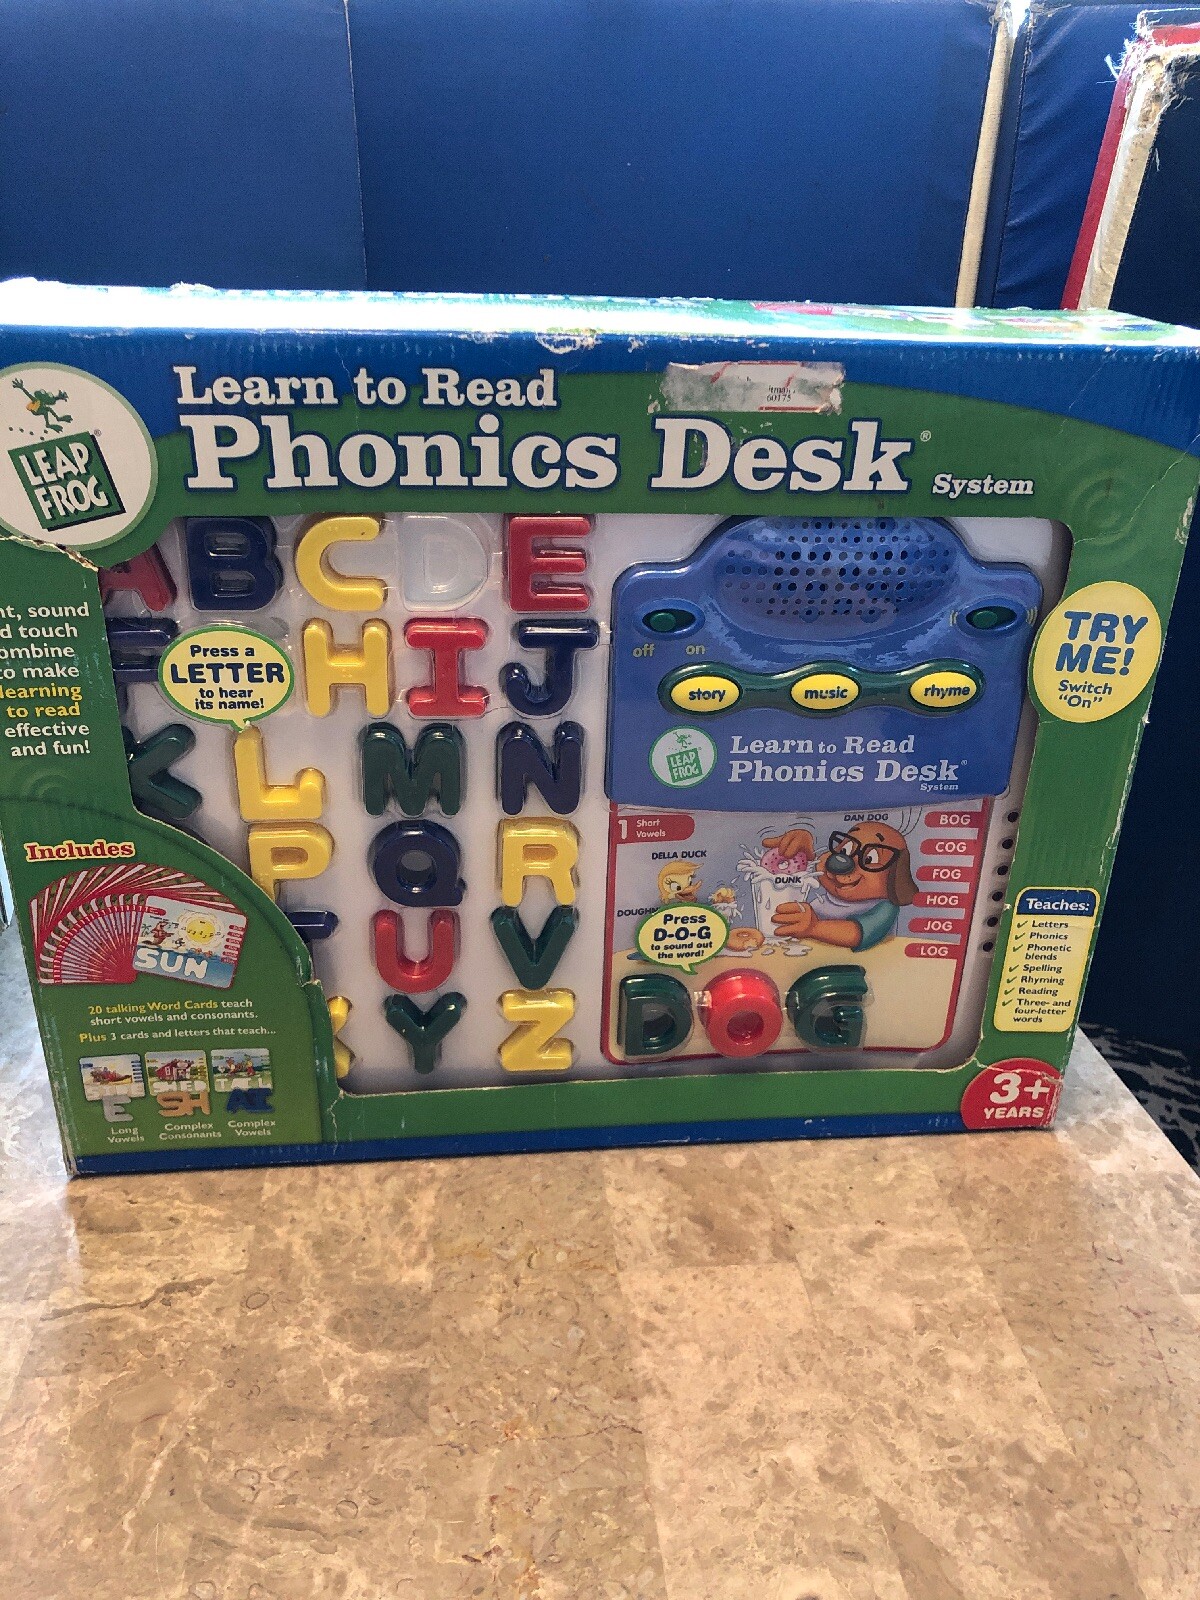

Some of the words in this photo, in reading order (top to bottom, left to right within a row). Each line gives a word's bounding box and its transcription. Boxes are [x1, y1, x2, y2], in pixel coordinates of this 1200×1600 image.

[173, 366, 338, 406] Learn
[354, 368, 407, 406] to
[421, 368, 558, 407] Read
[180, 414, 618, 490] Phonics
[651, 417, 915, 492] Desk
[19, 442, 90, 486] LEAP
[932, 473, 1035, 499] System
[34, 475, 109, 520] FROG
[187, 515, 283, 611] B
[295, 514, 389, 611] C
[402, 514, 490, 611] D
[506, 515, 593, 613] E
[28, 602, 90, 618] sound
[18, 623, 78, 638] touch
[1064, 610, 1149, 645] TRY
[190, 645, 241, 658] Press
[244, 647, 256, 657] a
[632, 643, 655, 659] off
[686, 644, 706, 656] on
[1055, 642, 1135, 676] ME!
[23, 663, 80, 679] make
[170, 663, 285, 684] LETTER
[302, 618, 394, 719] H
[405, 618, 490, 719] I
[499, 618, 599, 718] J
[0, 683, 83, 701] learning
[199, 688, 215, 699] to
[218, 687, 254, 699] hear
[688, 687, 726, 703] story
[804, 686, 848, 700] music
[923, 683, 970, 700] rhyme
[1058, 680, 1113, 695] Switch
[7, 706, 29, 719] to
[35, 702, 81, 717] read
[194, 698, 214, 710] its
[218, 698, 265, 710] name!
[5, 721, 90, 738] effective
[11, 741, 47, 757] and
[53, 740, 91, 755] fun!
[730, 735, 814, 755] Learn
[818, 740, 837, 755] to
[842, 735, 915, 754] Read
[670, 752, 696, 768] LEAP
[233, 724, 326, 820] L
[361, 721, 469, 816] M
[496, 721, 586, 816] N
[673, 763, 700, 780] FROG
[727, 760, 864, 783] Phonics
[874, 760, 960, 783] Desk
[920, 782, 960, 793] System
[843, 813, 864, 823] DAN
[866, 812, 889, 822] DOG
[939, 814, 971, 826] BOG
[617, 820, 627, 840] 1
[635, 819, 660, 829] Short
[635, 828, 667, 839] Vowels
[25, 840, 135, 861] Includes
[934, 841, 967, 853] COG
[370, 819, 467, 907] Q
[497, 817, 580, 906] R
[651, 851, 680, 861] DELLA
[682, 849, 707, 860] DUCK
[774, 875, 801, 885] DUNK
[932, 868, 962, 880] FOG
[926, 893, 959, 905] HOG
[1026, 898, 1090, 912] Teaches:
[663, 914, 707, 926] Press
[923, 920, 953, 932] JOG
[1031, 920, 1069, 929] Letters
[653, 926, 712, 942] D-O-G
[1029, 932, 1069, 941] Phonics
[372, 909, 461, 994] U
[491, 906, 579, 990] V
[663, 942, 693, 951] sound
[696, 941, 713, 949] out
[920, 945, 949, 957] LOG
[1027, 943, 1072, 952] Phonetic
[657, 952, 674, 960] the
[676, 950, 705, 959] word!
[1024, 952, 1058, 961] blends
[134, 947, 208, 979] SUN
[1022, 964, 1063, 974] Spelling
[1020, 975, 1065, 986] Rhyming
[1018, 987, 1059, 997] Reading
[88, 1005, 103, 1015] 20
[106, 1003, 146, 1014] talking
[147, 1001, 181, 1011] Word
[184, 1000, 219, 1010] Cards
[221, 998, 253, 1008] teach
[1017, 998, 1051, 1008] Three-
[1052, 998, 1072, 1008] and
[90, 1016, 122, 1026] short
[125, 1013, 163, 1024] vowels
[167, 1011, 188, 1021] and
[190, 1011, 258, 1021] consonants.
[1014, 1007, 1067, 1016] four-letter
[1012, 1015, 1043, 1024] words
[80, 1032, 107, 1043] Plus
[110, 1032, 117, 1041] 3
[120, 1030, 149, 1040] cards
[152, 1029, 172, 1039] and
[174, 1028, 210, 1037] letters
[213, 1027, 235, 1036] that
[383, 992, 467, 1074] Y
[497, 987, 576, 1071] Z
[989, 1072, 1050, 1105] 3+
[983, 1107, 1044, 1120] YEARS
[164, 1121, 214, 1132] Complex
[227, 1119, 276, 1129] Complex
[107, 1135, 145, 1144] Vowels
[110, 1127, 139, 1137] Long
[159, 1130, 222, 1141] Consonants
[234, 1128, 272, 1137] Vowels
